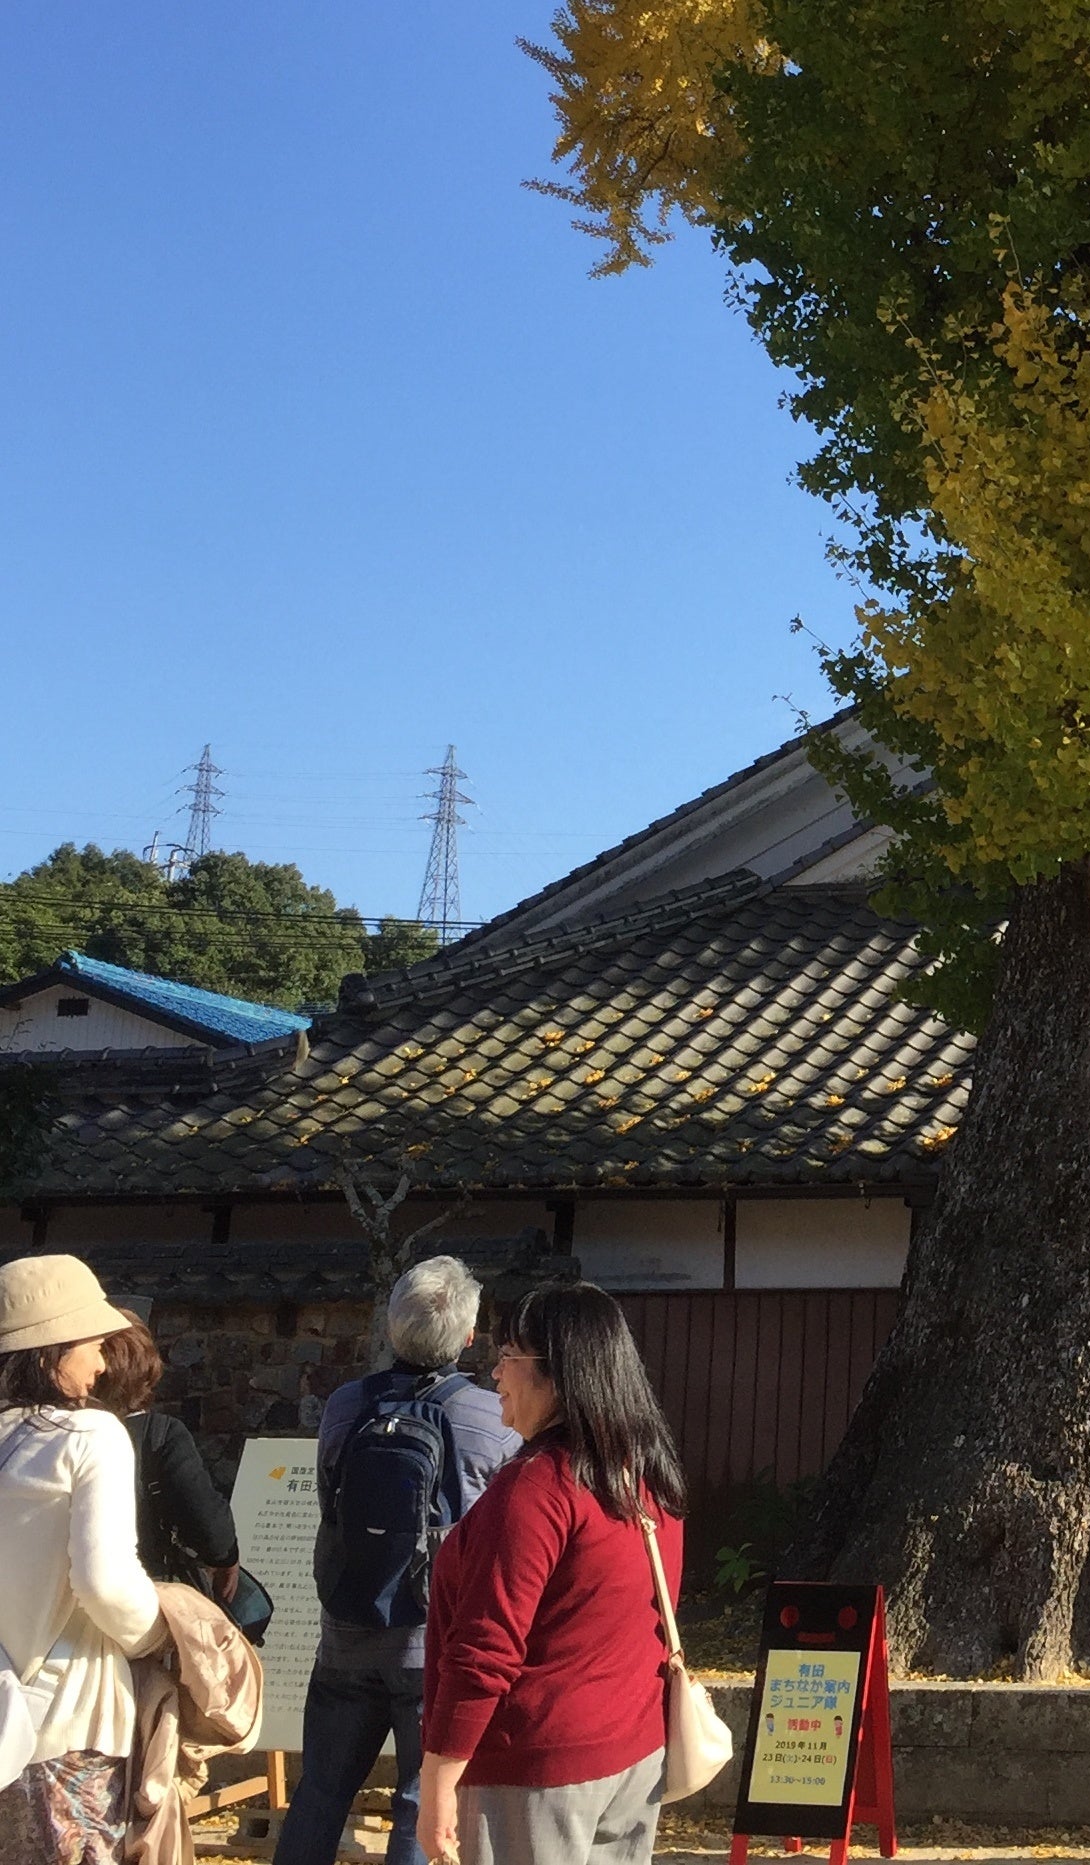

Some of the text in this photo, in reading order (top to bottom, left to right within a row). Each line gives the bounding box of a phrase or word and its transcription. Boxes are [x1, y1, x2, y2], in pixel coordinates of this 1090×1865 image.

[799, 1664, 825, 1678] 有田
[770, 1679, 851, 1694] まちなか案内
[788, 1718, 821, 1731] 活動中
